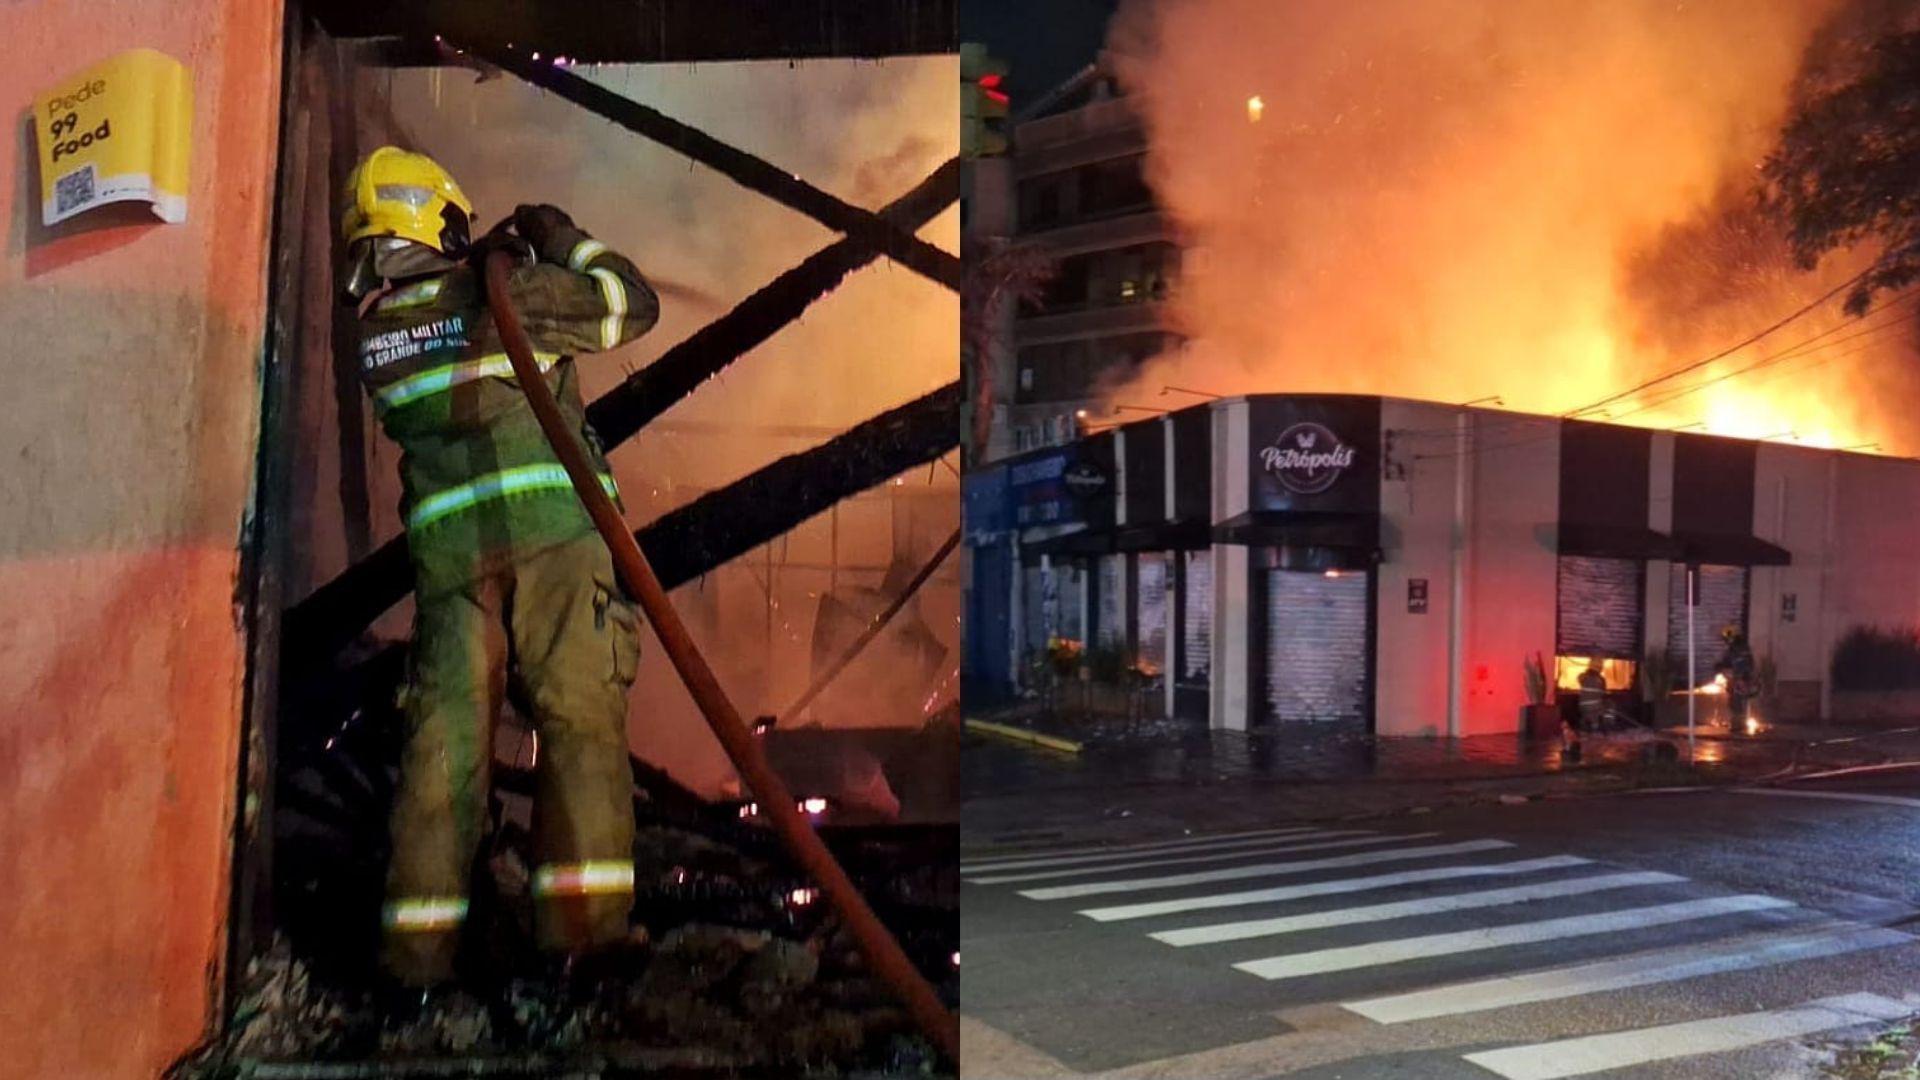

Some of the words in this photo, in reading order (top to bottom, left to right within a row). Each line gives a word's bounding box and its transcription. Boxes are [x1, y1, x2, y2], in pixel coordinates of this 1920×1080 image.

[48, 79, 107, 118] Pede
[51, 112, 78, 140] 99
[51, 119, 111, 162] Food
[363, 330, 409, 352] MBEIRO
[411, 317, 463, 339] MILITAR
[375, 343, 421, 367] GRANDE
[424, 338, 442, 351] DO
[1260, 444, 1355, 477] Petrópolis
